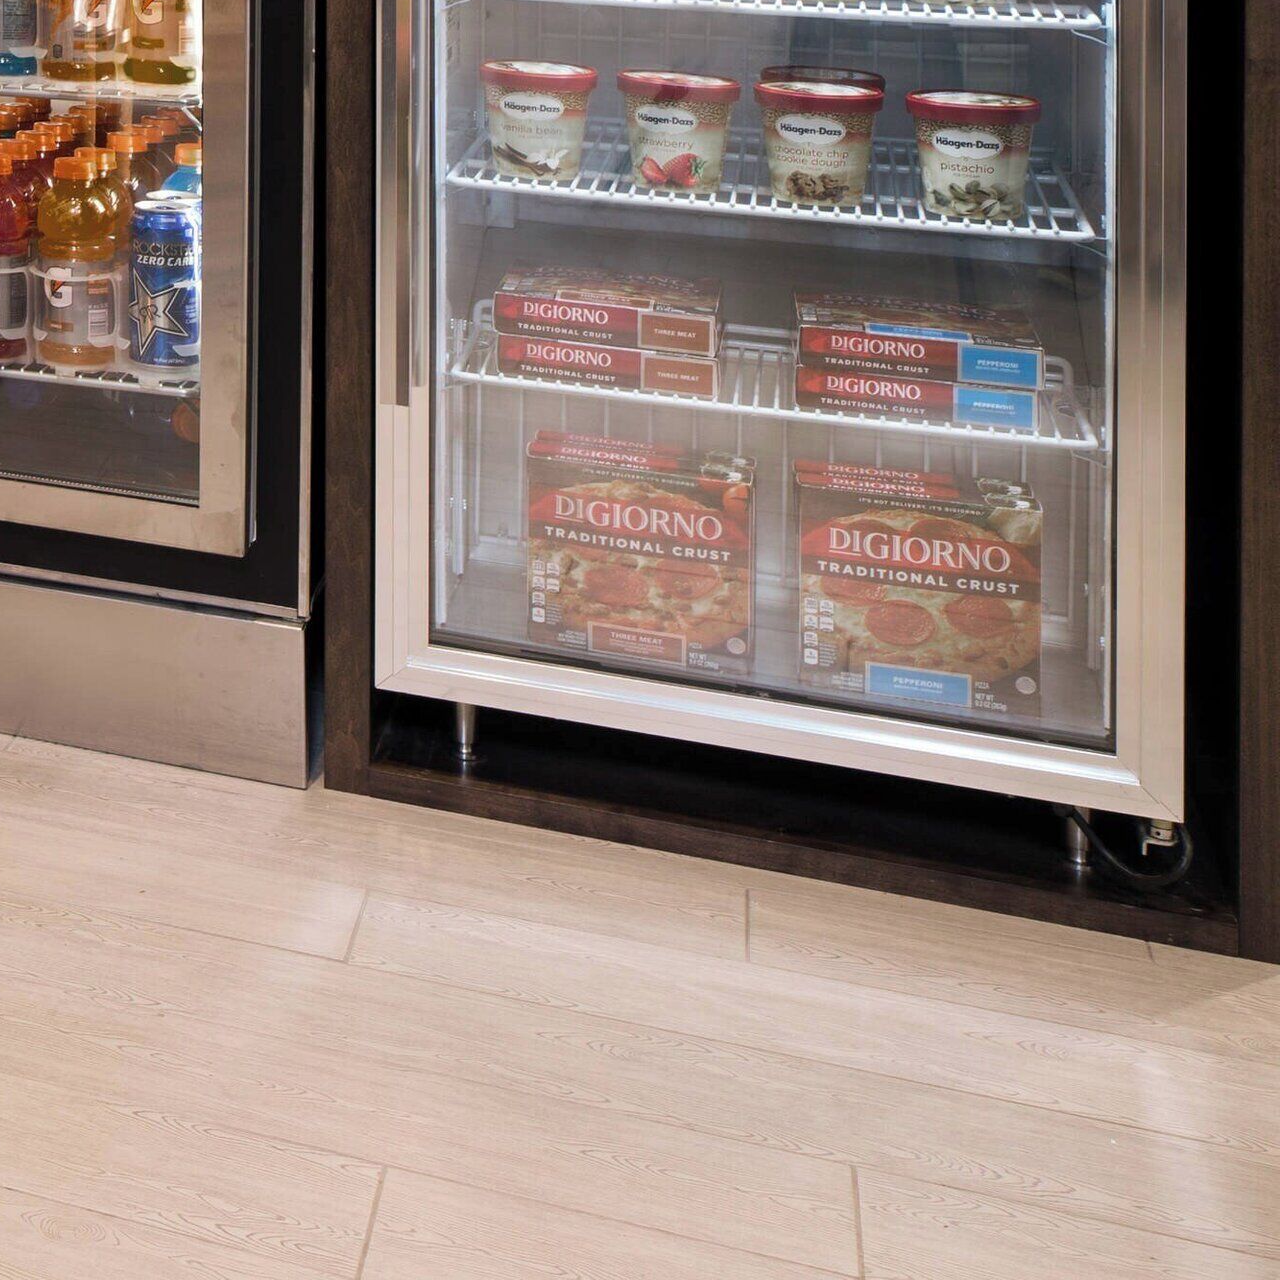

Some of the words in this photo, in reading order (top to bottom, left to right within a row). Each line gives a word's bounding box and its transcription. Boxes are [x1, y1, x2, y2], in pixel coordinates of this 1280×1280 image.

[504, 101, 561, 114] Häagen-Dazs
[779, 122, 843, 137] Häagen-Dazs
[935, 135, 1001, 152] Häagen-Dazs
[811, 155, 847, 168] dough
[826, 147, 850, 160] chip
[940, 162, 995, 175] pistachio
[137, 254, 165, 266] ZERO
[44, 266, 73, 308] G
[517, 322, 580, 337] TRADITIONAL
[582, 329, 613, 341] CRUST
[824, 356, 894, 371] TRADITIONAL
[896, 363, 930, 375] CRUST
[976, 358, 1019, 370] PEPPERONI
[520, 363, 583, 379] TRADITIONAL
[585, 371, 617, 384] CRUST
[820, 396, 890, 412] TRADITIONAL
[891, 404, 926, 416] CRUST
[554, 494, 724, 541] DIGIORNO
[544, 524, 666, 556] TRADITIONAL
[671, 545, 732, 563] CRUST
[816, 559, 949, 588] TRADITIONAL
[955, 578, 1021, 596] CRUST
[610, 631, 638, 642] THREE
[639, 636, 664, 646] MEAT
[892, 675, 944, 690] PEPPERONI
